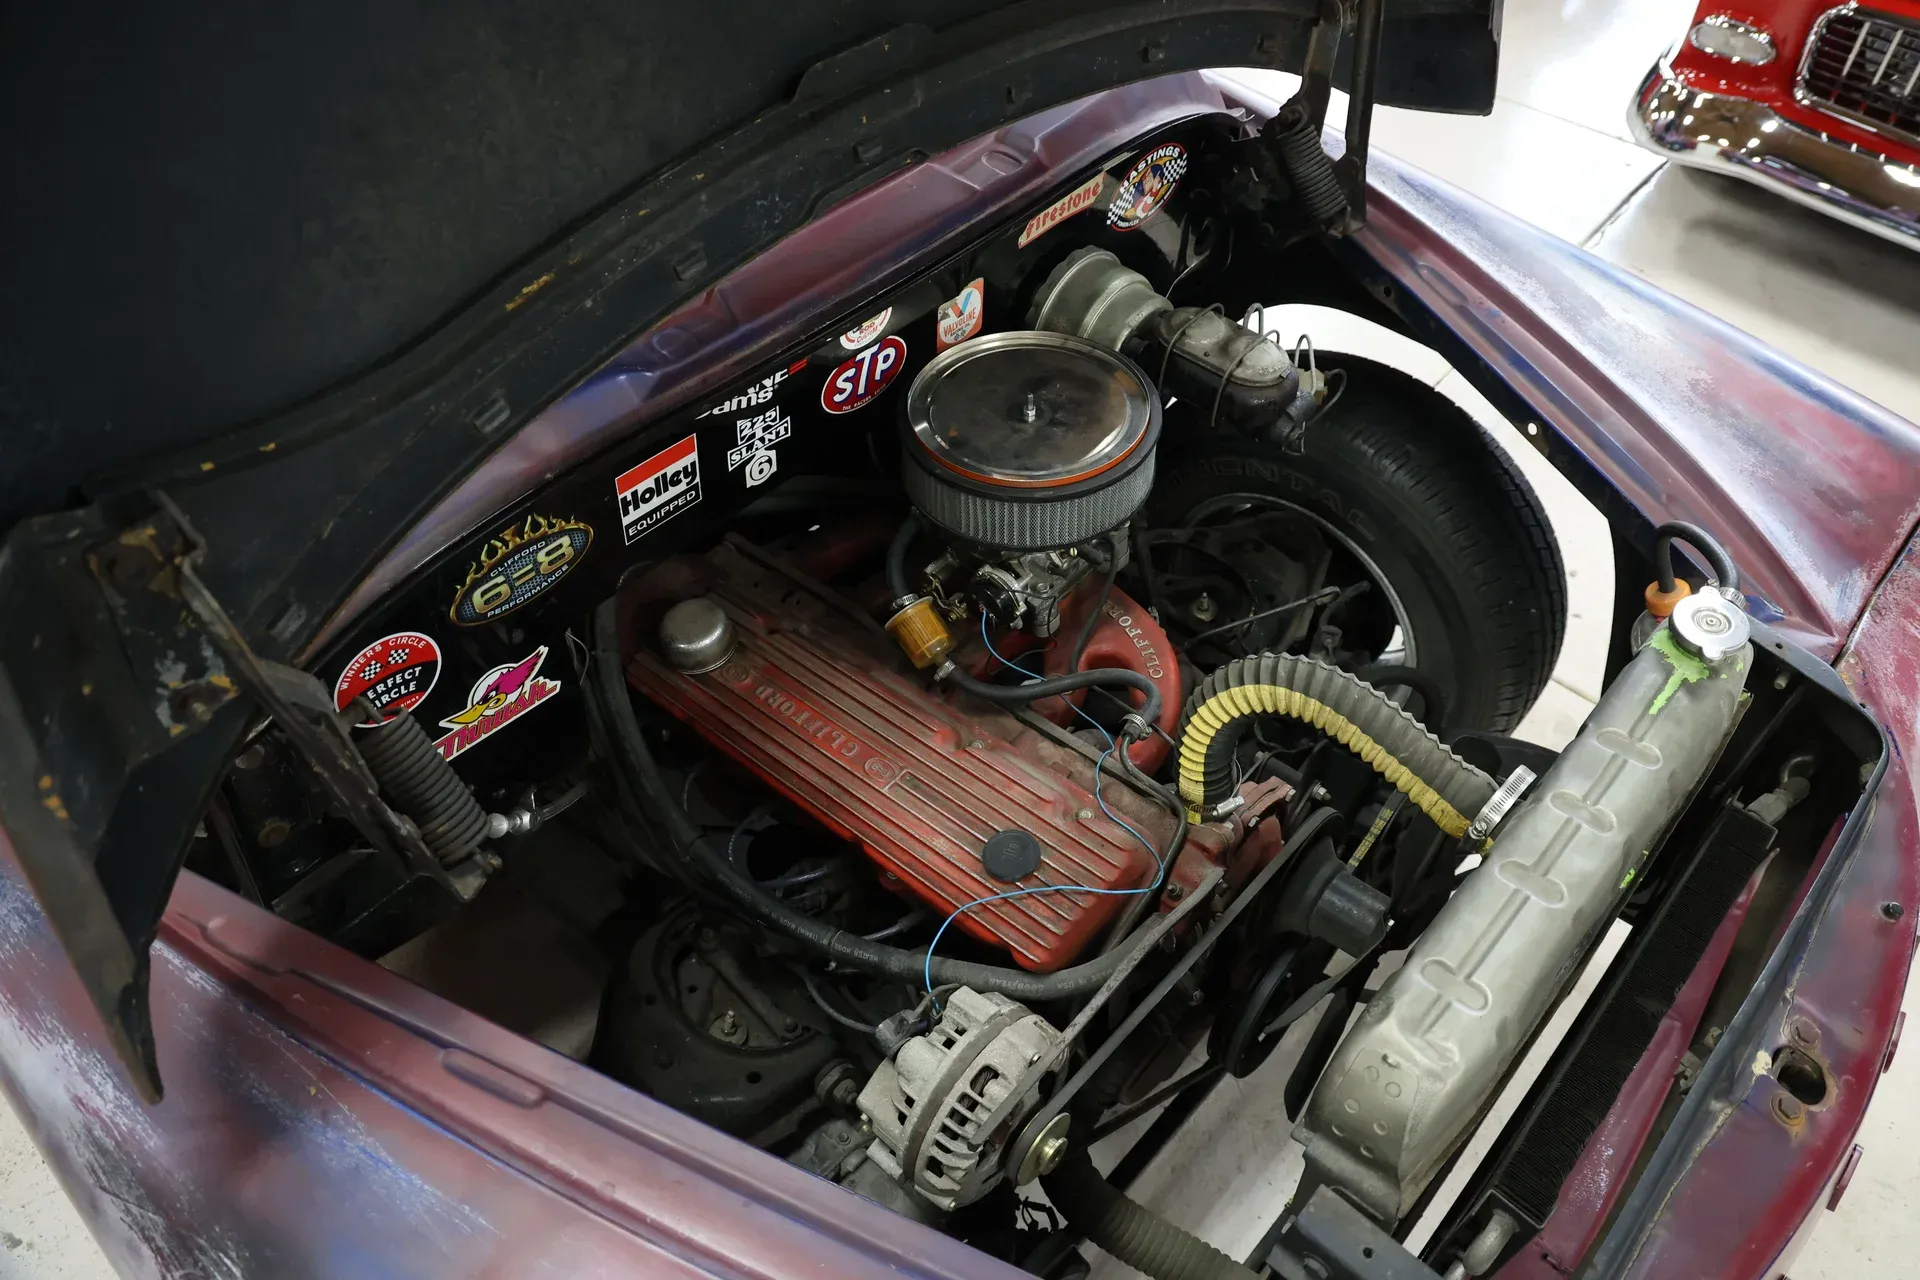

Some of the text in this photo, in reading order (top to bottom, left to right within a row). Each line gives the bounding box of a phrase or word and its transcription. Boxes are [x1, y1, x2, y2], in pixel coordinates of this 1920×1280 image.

[1025, 181, 1101, 240] Firestone
[943, 307, 977, 338] VALVOLINE
[833, 341, 896, 402] STP
[740, 409, 777, 437] 225
[730, 423, 788, 465] SLANT
[751, 454, 770, 481] 6
[619, 459, 698, 518] Holley
[628, 490, 696, 537] EQUIPPED
[471, 535, 575, 616] 6=8
[490, 541, 546, 578] CLIFFORD
[487, 563, 570, 618] PERFORMANCE
[340, 636, 427, 690] WINNERS CIRCLE
[366, 666, 422, 699] ERFECT
[373, 681, 417, 710] IRCLE
[436, 678, 558, 759] Thrush
[755, 685, 858, 757] CLIFFORD
[779, 916, 796, 930] MADE
[834, 942, 852, 954] HOSE
[853, 949, 879, 962] HEATER
[1057, 981, 1075, 989] USA
